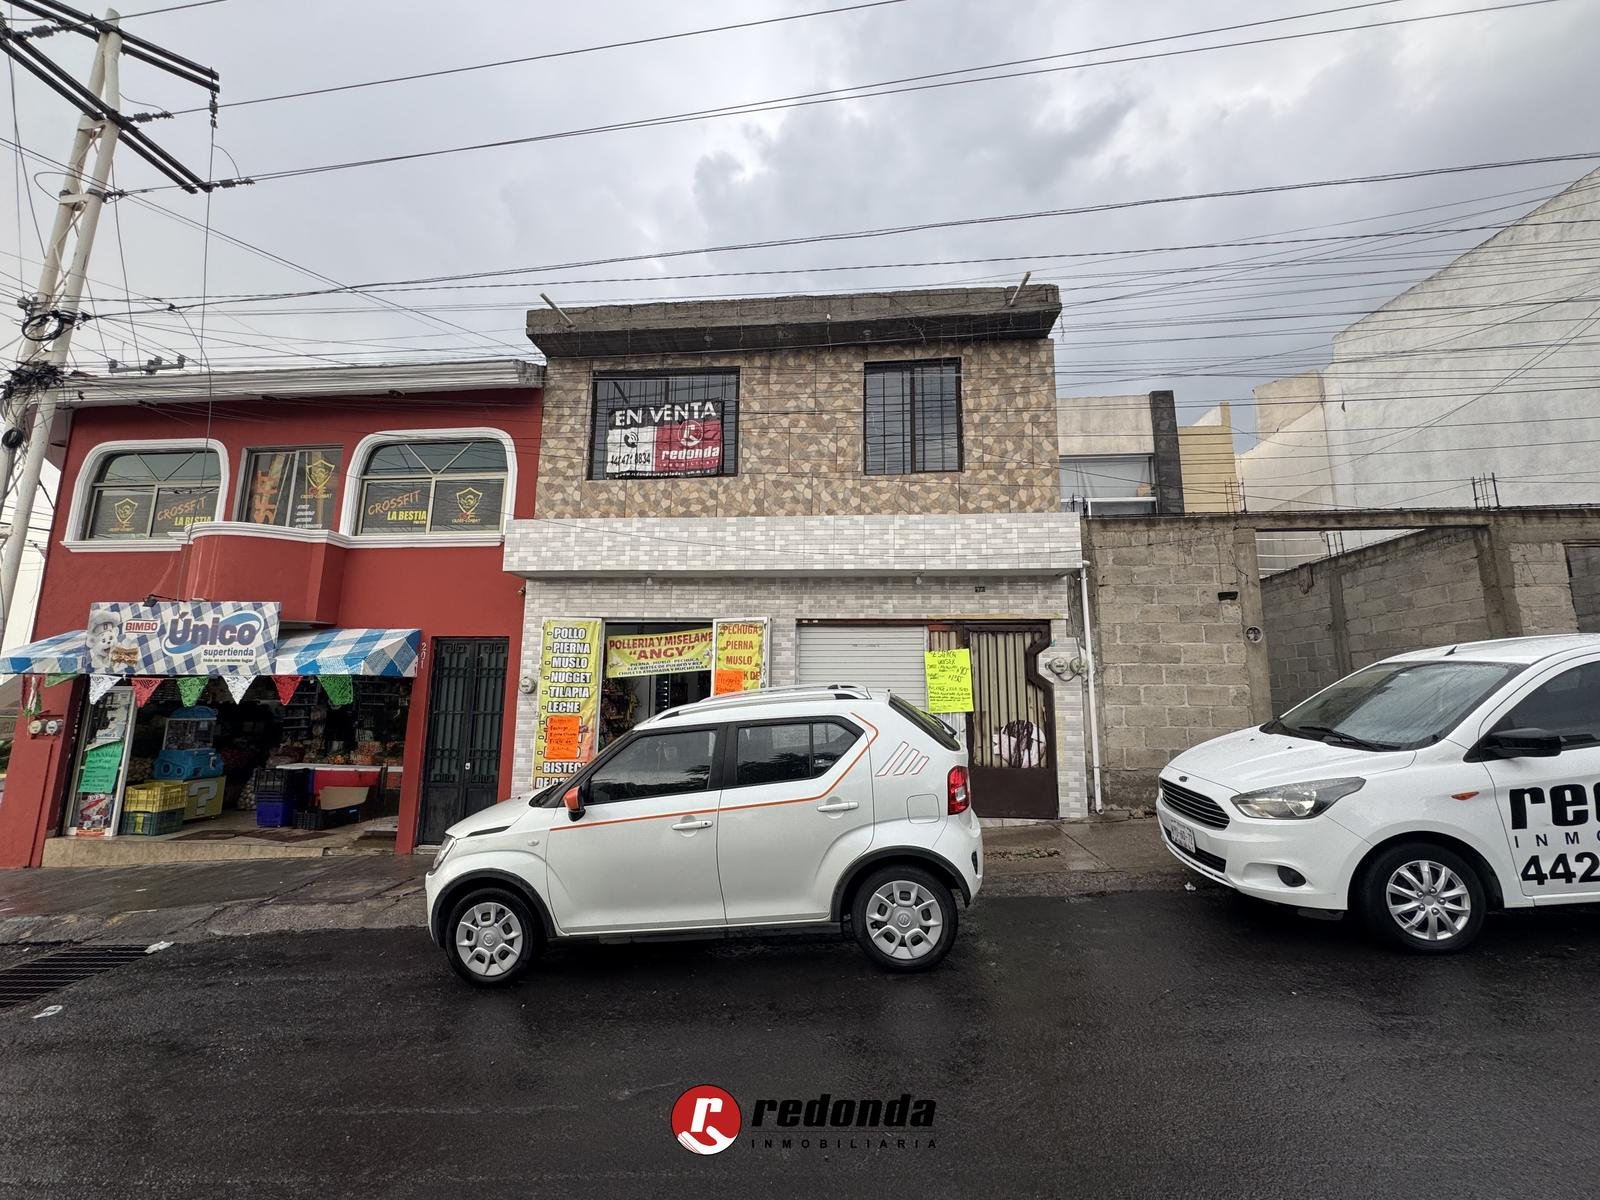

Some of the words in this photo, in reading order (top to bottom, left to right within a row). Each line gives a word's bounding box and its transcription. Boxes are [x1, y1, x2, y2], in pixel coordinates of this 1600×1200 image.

[615, 409, 642, 426] EN
[649, 402, 716, 422] VENTA
[661, 445, 720, 460] redonda
[156, 496, 207, 521] CROSSFIT
[368, 490, 421, 516] CROSSFIT
[174, 516, 185, 526] LA
[387, 510, 397, 521] LA
[399, 510, 427, 521] BESTIA
[125, 622, 158, 632] BIMBO
[168, 611, 258, 646] Único
[553, 627, 587, 640] POLLO
[722, 624, 759, 635] PECHUGA
[609, 637, 655, 650] POLLERIA
[655, 636, 662, 647] Y
[664, 631, 713, 646] MISELANE
[726, 640, 754, 650] PIERNA
[203, 647, 254, 658] supertienda
[552, 642, 592, 655] PIERNA
[551, 656, 588, 669] MUSLO
[725, 655, 753, 665] MUSLO
[550, 671, 593, 684] NUGGET
[549, 686, 591, 699] TILAPIA
[547, 701, 581, 713] LECHE
[543, 761, 587, 774] BISTEC
[1509, 782, 1600, 830] re
[1514, 830, 1600, 849] INM
[1521, 851, 1600, 885] 442
